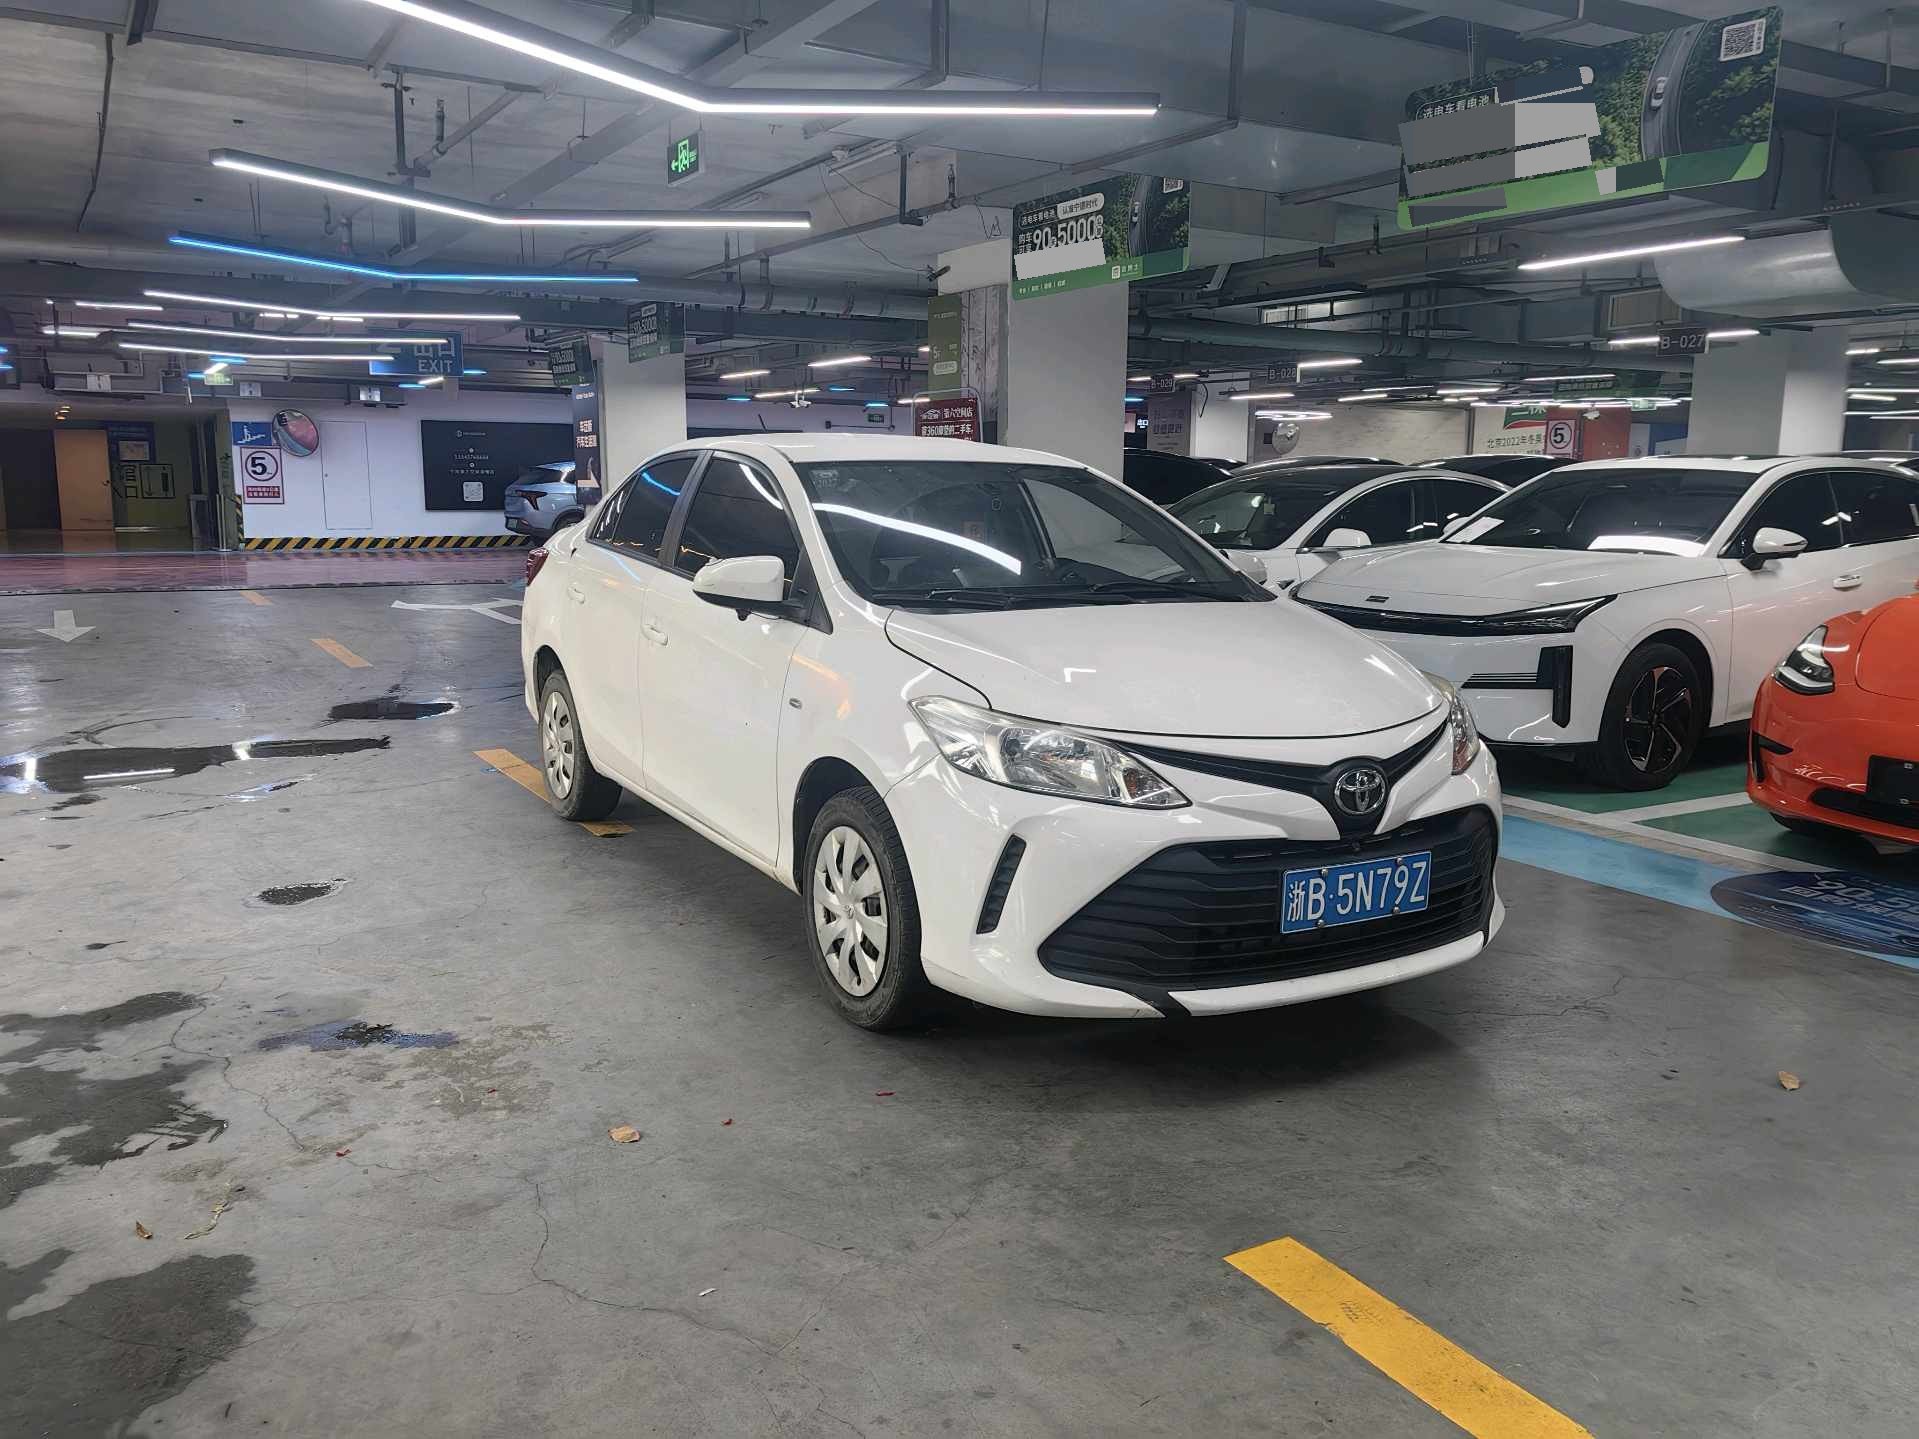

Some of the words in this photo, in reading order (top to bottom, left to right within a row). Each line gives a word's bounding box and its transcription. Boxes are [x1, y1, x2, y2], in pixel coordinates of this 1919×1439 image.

[1660, 334, 1704, 350] B-027
[418, 360, 453, 373] EXIT
[1269, 368, 1297, 379] B-028
[1552, 427, 1566, 444] 5
[250, 456, 268, 476] 5
